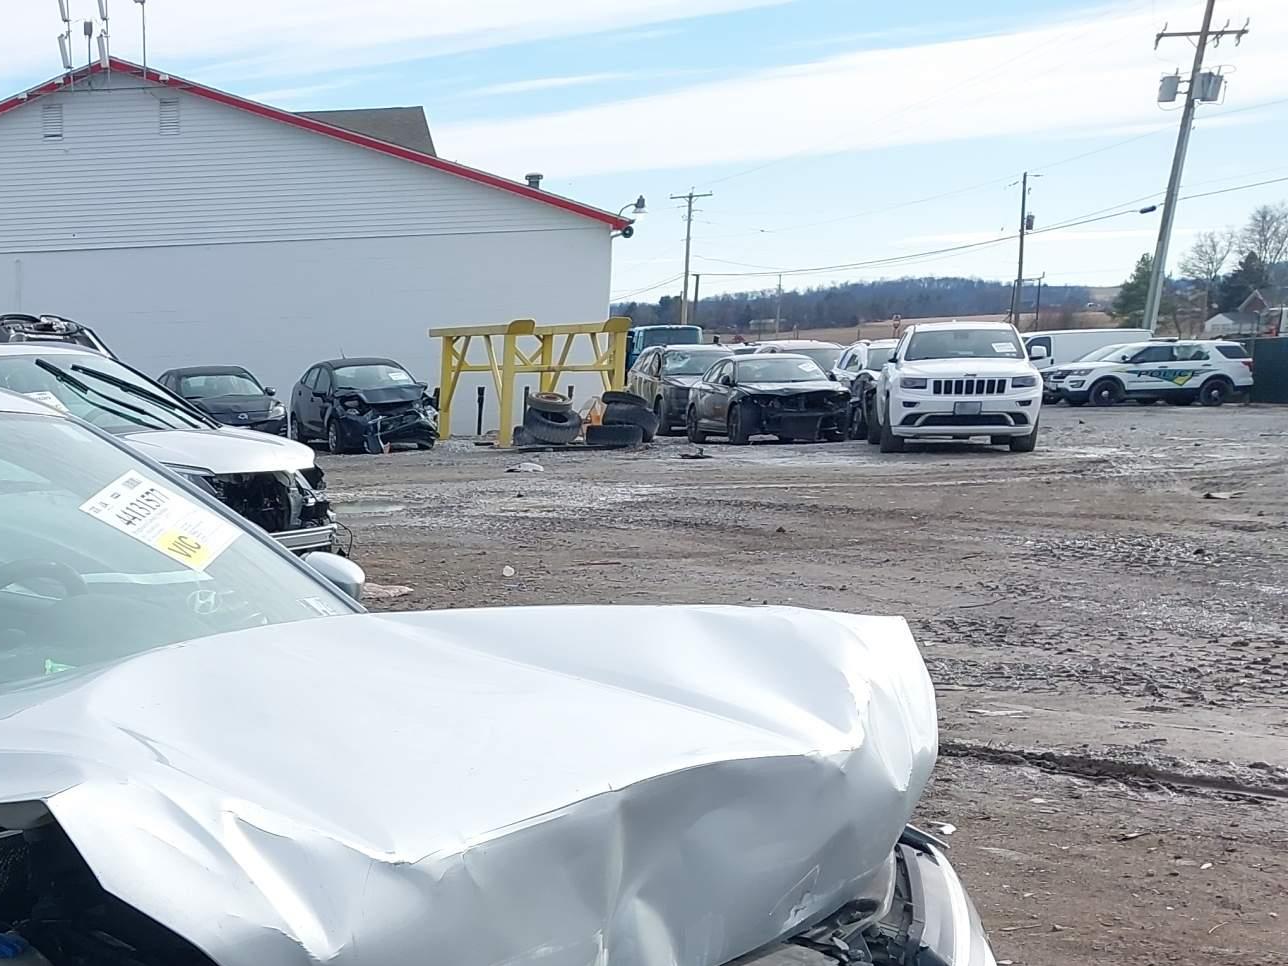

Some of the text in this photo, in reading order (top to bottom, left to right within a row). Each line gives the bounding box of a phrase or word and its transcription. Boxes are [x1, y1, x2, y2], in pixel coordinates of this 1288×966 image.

[1137, 369, 1202, 378] POLICE
[116, 488, 170, 526] 44131577
[167, 535, 201, 559] VIC
